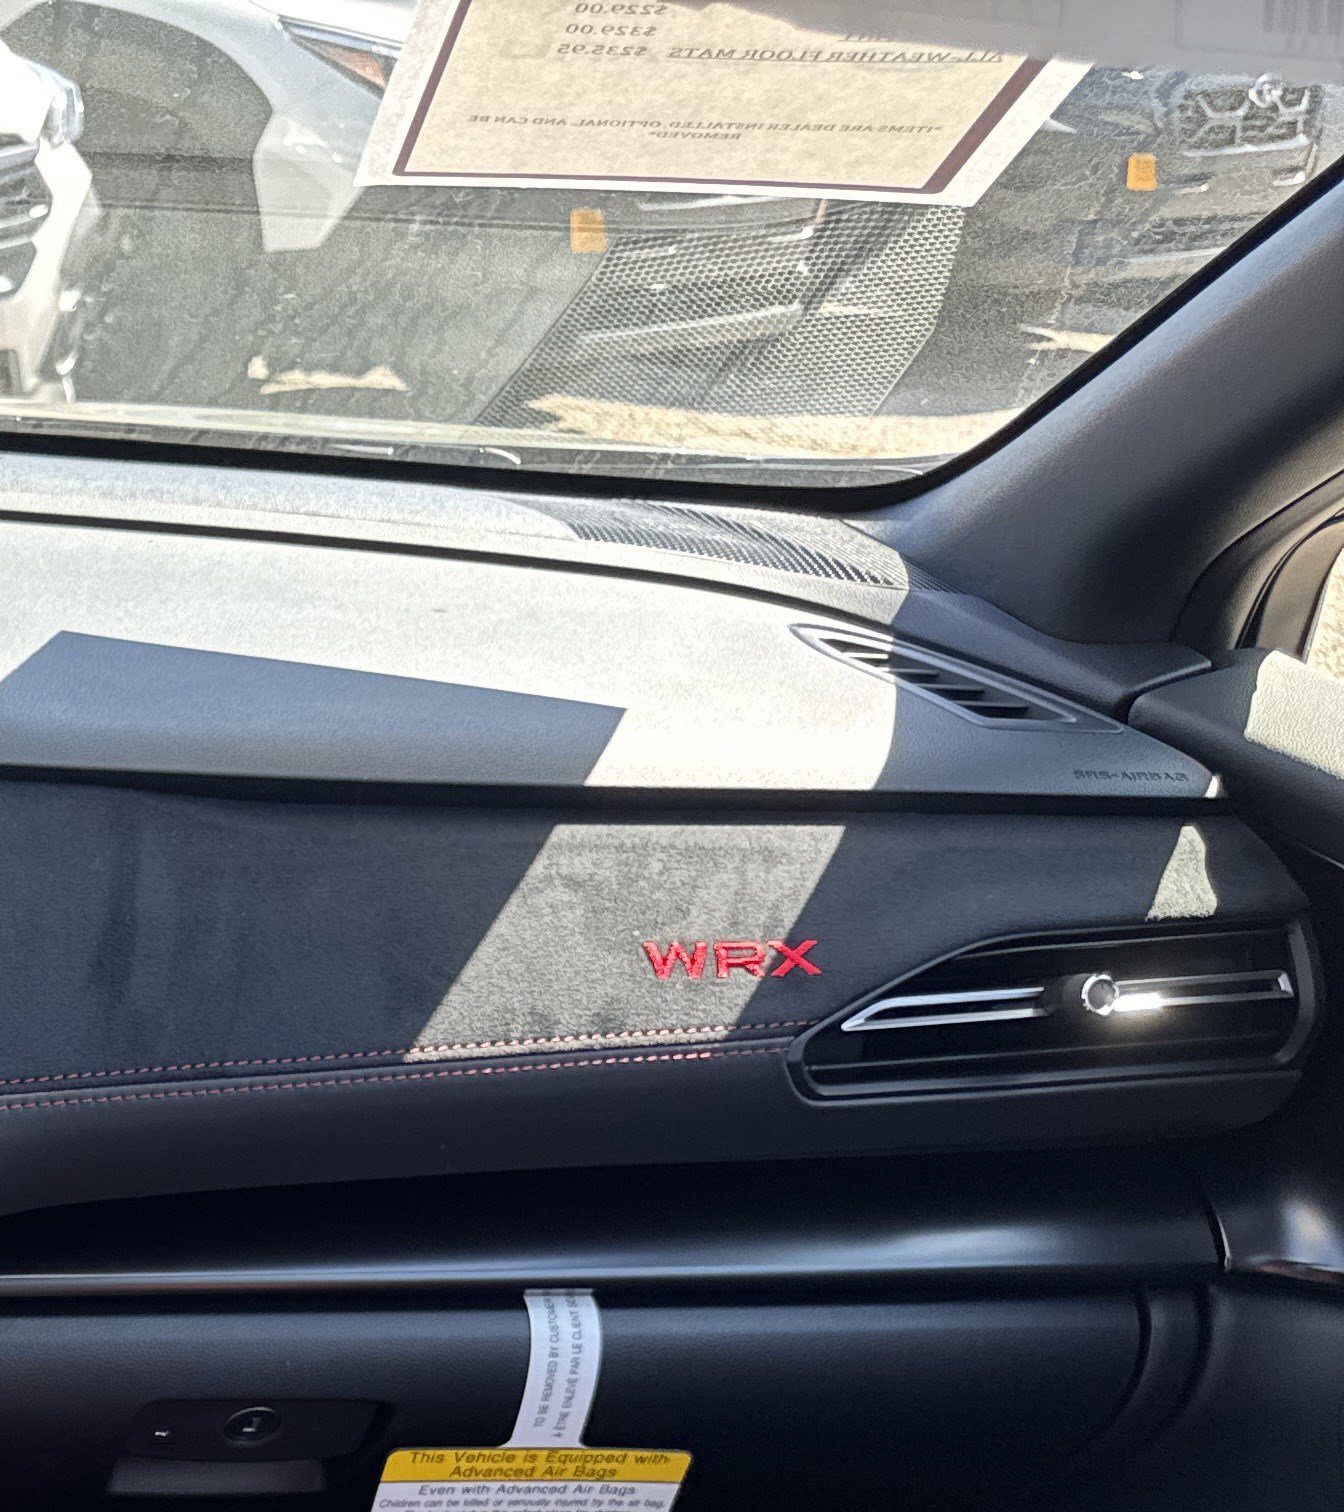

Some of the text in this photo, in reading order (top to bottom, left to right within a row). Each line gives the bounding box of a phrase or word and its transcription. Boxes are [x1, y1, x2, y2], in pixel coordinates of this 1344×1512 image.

[641, 939, 823, 980] WRX
[548, 1345, 559, 1359] BY
[410, 1450, 670, 1466] This Vehicle is Equipped with
[448, 1464, 618, 1480] Advanced Air Bags
[418, 1484, 637, 1497] Even with Advanced Air Bags
